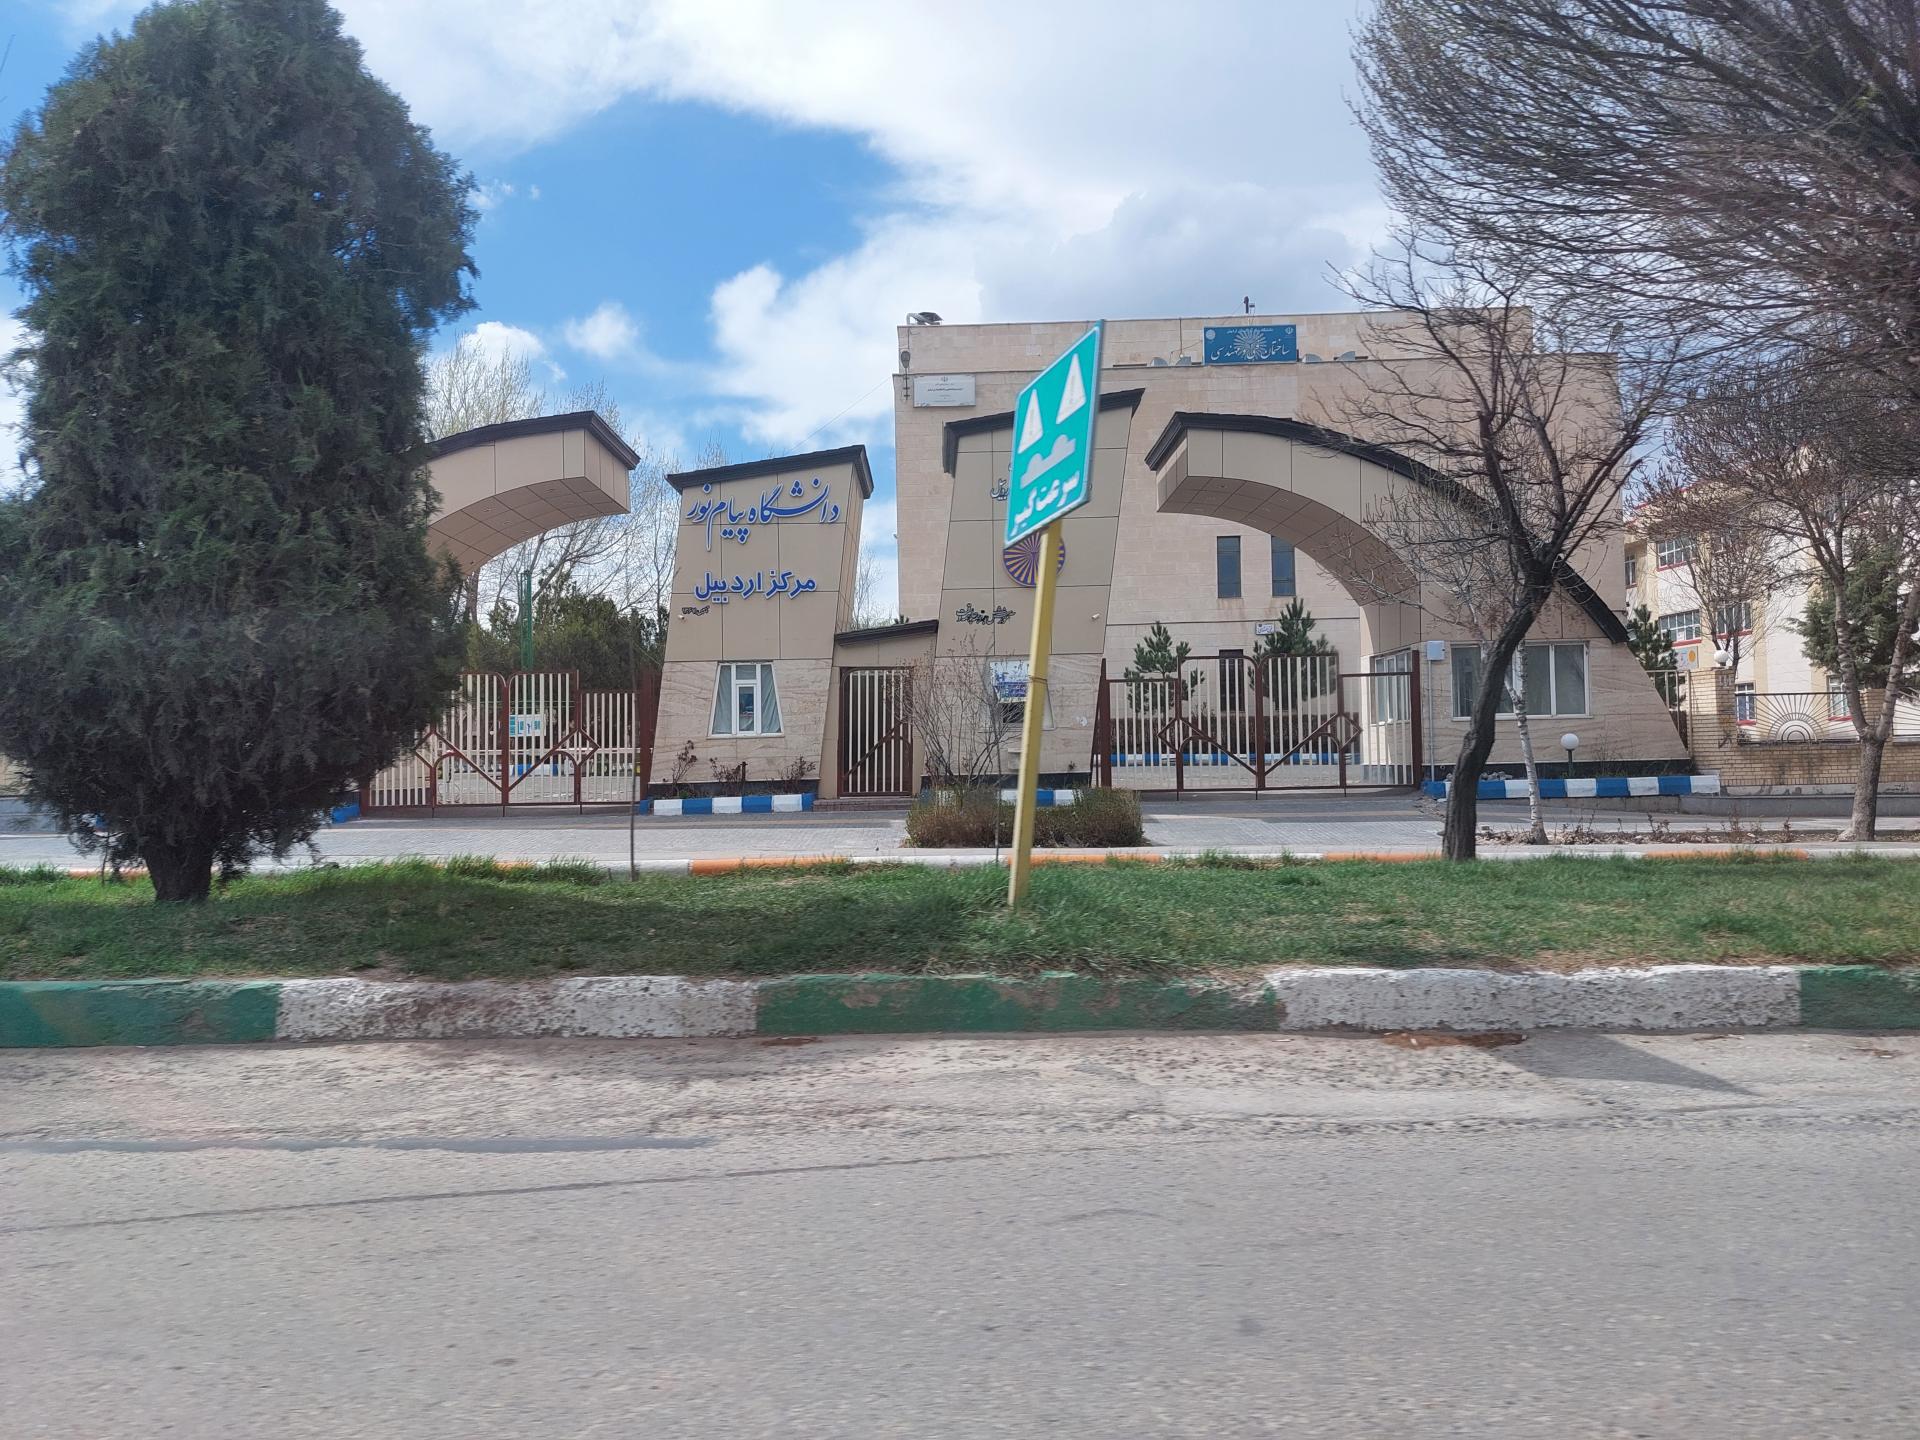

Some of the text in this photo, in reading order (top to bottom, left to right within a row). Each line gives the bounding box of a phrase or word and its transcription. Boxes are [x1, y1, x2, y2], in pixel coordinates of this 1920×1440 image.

[687, 477, 840, 551] دانشگاه پیام نور
[694, 569, 817, 604] مرکز اردبیل
